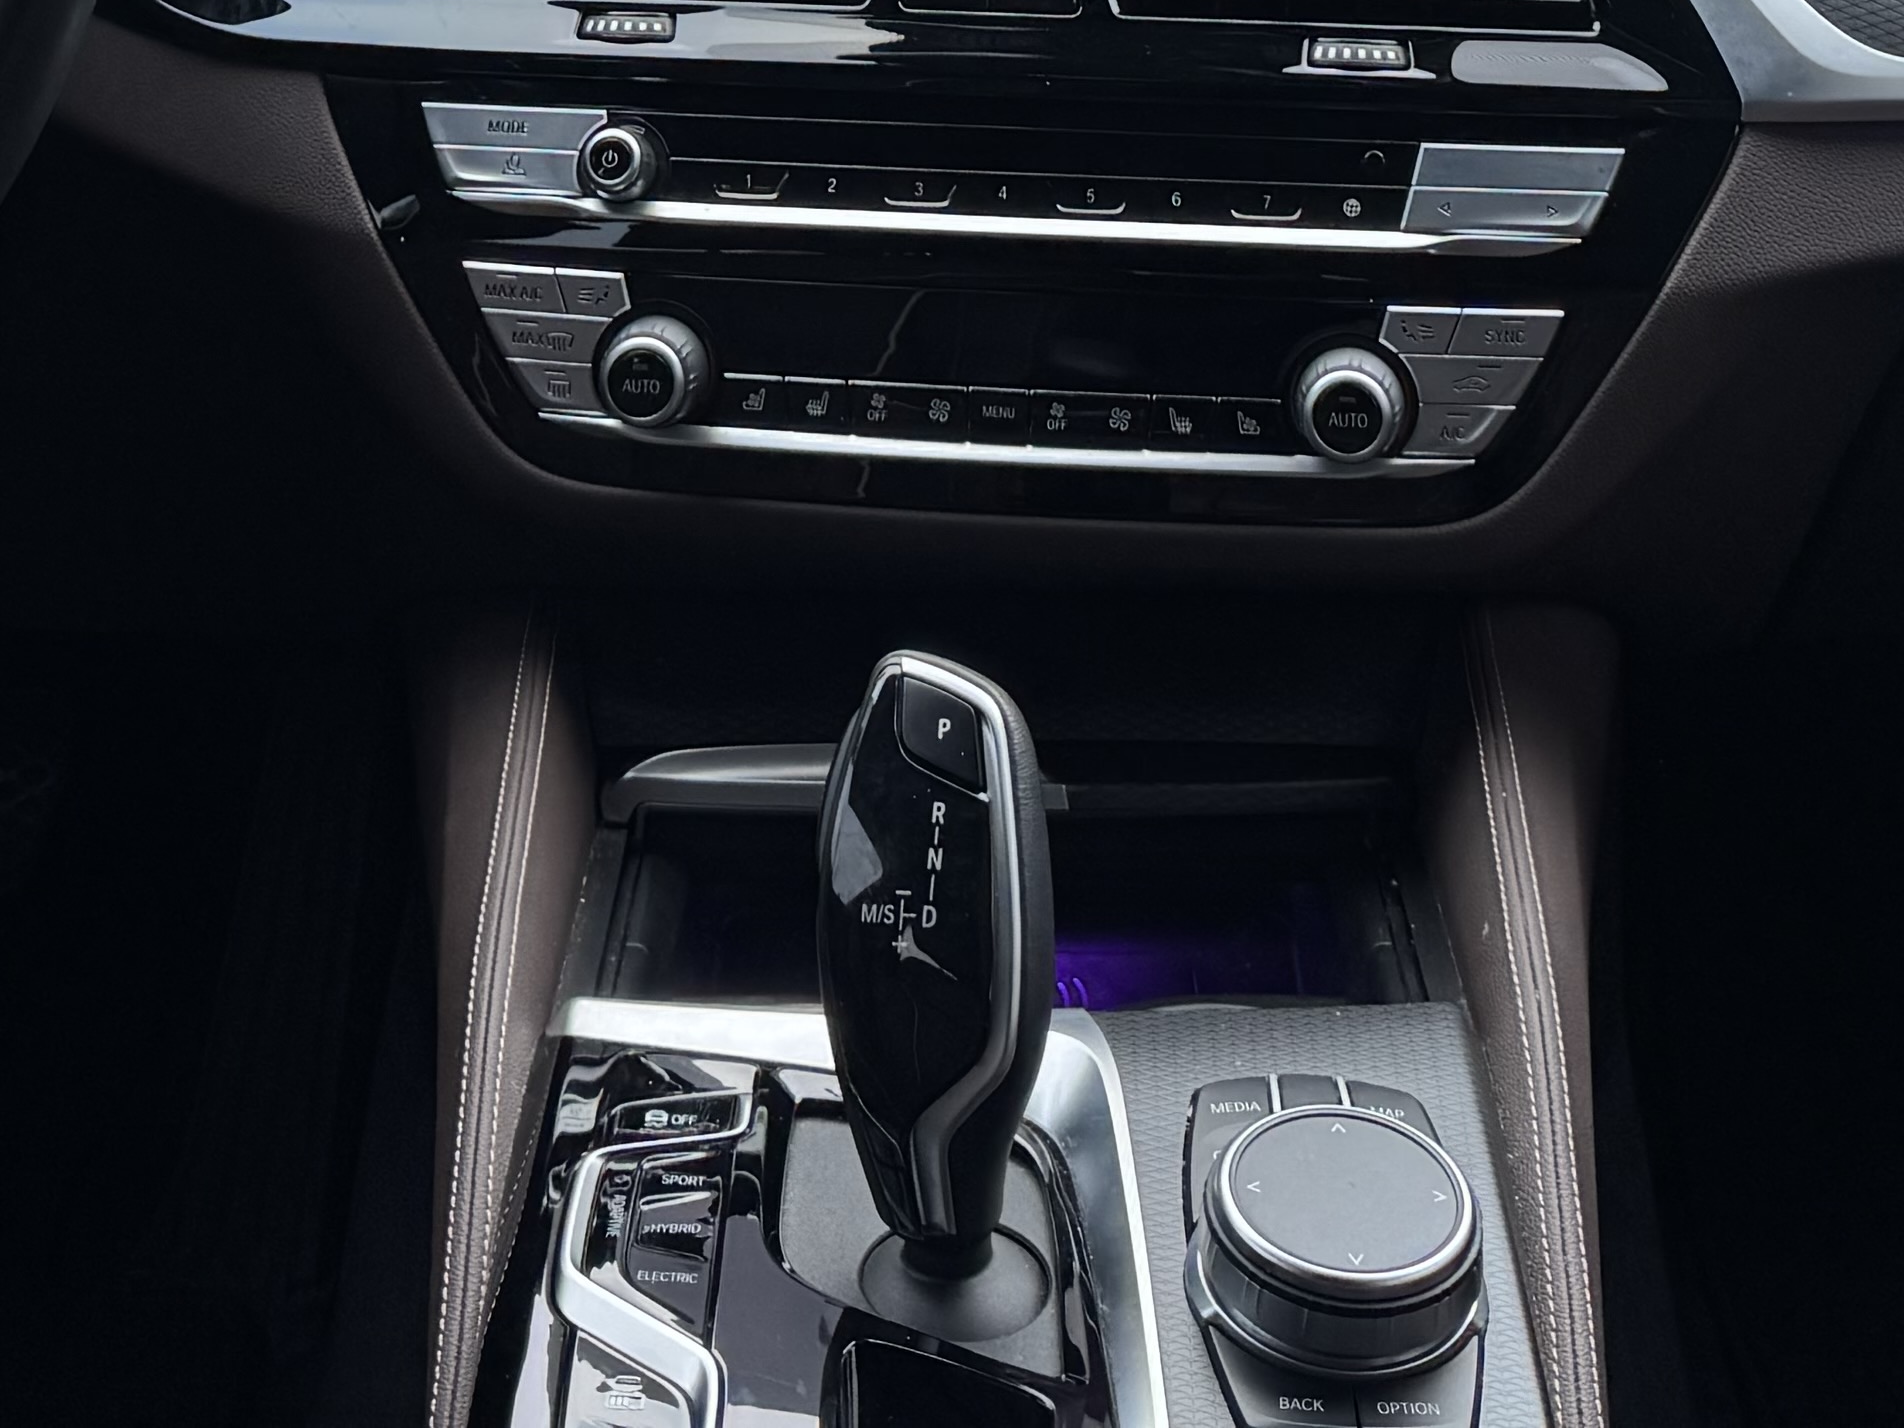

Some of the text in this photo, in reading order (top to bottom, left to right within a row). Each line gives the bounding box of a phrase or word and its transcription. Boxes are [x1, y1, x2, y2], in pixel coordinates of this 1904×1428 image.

[487, 119, 529, 136] MODE
[827, 178, 837, 193] 2
[914, 181, 923, 197] 3
[998, 185, 1007, 200] 4
[1086, 188, 1095, 204] 5
[1172, 191, 1181, 207] 6
[1263, 195, 1271, 210] 7
[484, 283, 543, 302] MAX A/C
[512, 330, 542, 347] MAX
[1484, 329, 1527, 346] SYNC
[622, 378, 661, 394] AUTO
[867, 409, 889, 422] OFF
[982, 405, 1016, 419] MENU
[1328, 411, 1369, 428] AUTO
[1046, 418, 1068, 431] OFF
[936, 717, 951, 740] P
[931, 800, 946, 826] R
[926, 846, 944, 871] N
[860, 903, 937, 929] M/S D
[1209, 1100, 1262, 1115] MEDIA
[670, 1113, 698, 1126] OFF
[661, 1174, 707, 1187] SPORT
[636, 1269, 699, 1285] ELECTRIC
[1278, 1396, 1325, 1413] BACK
[1376, 1399, 1442, 1418] OPTION
